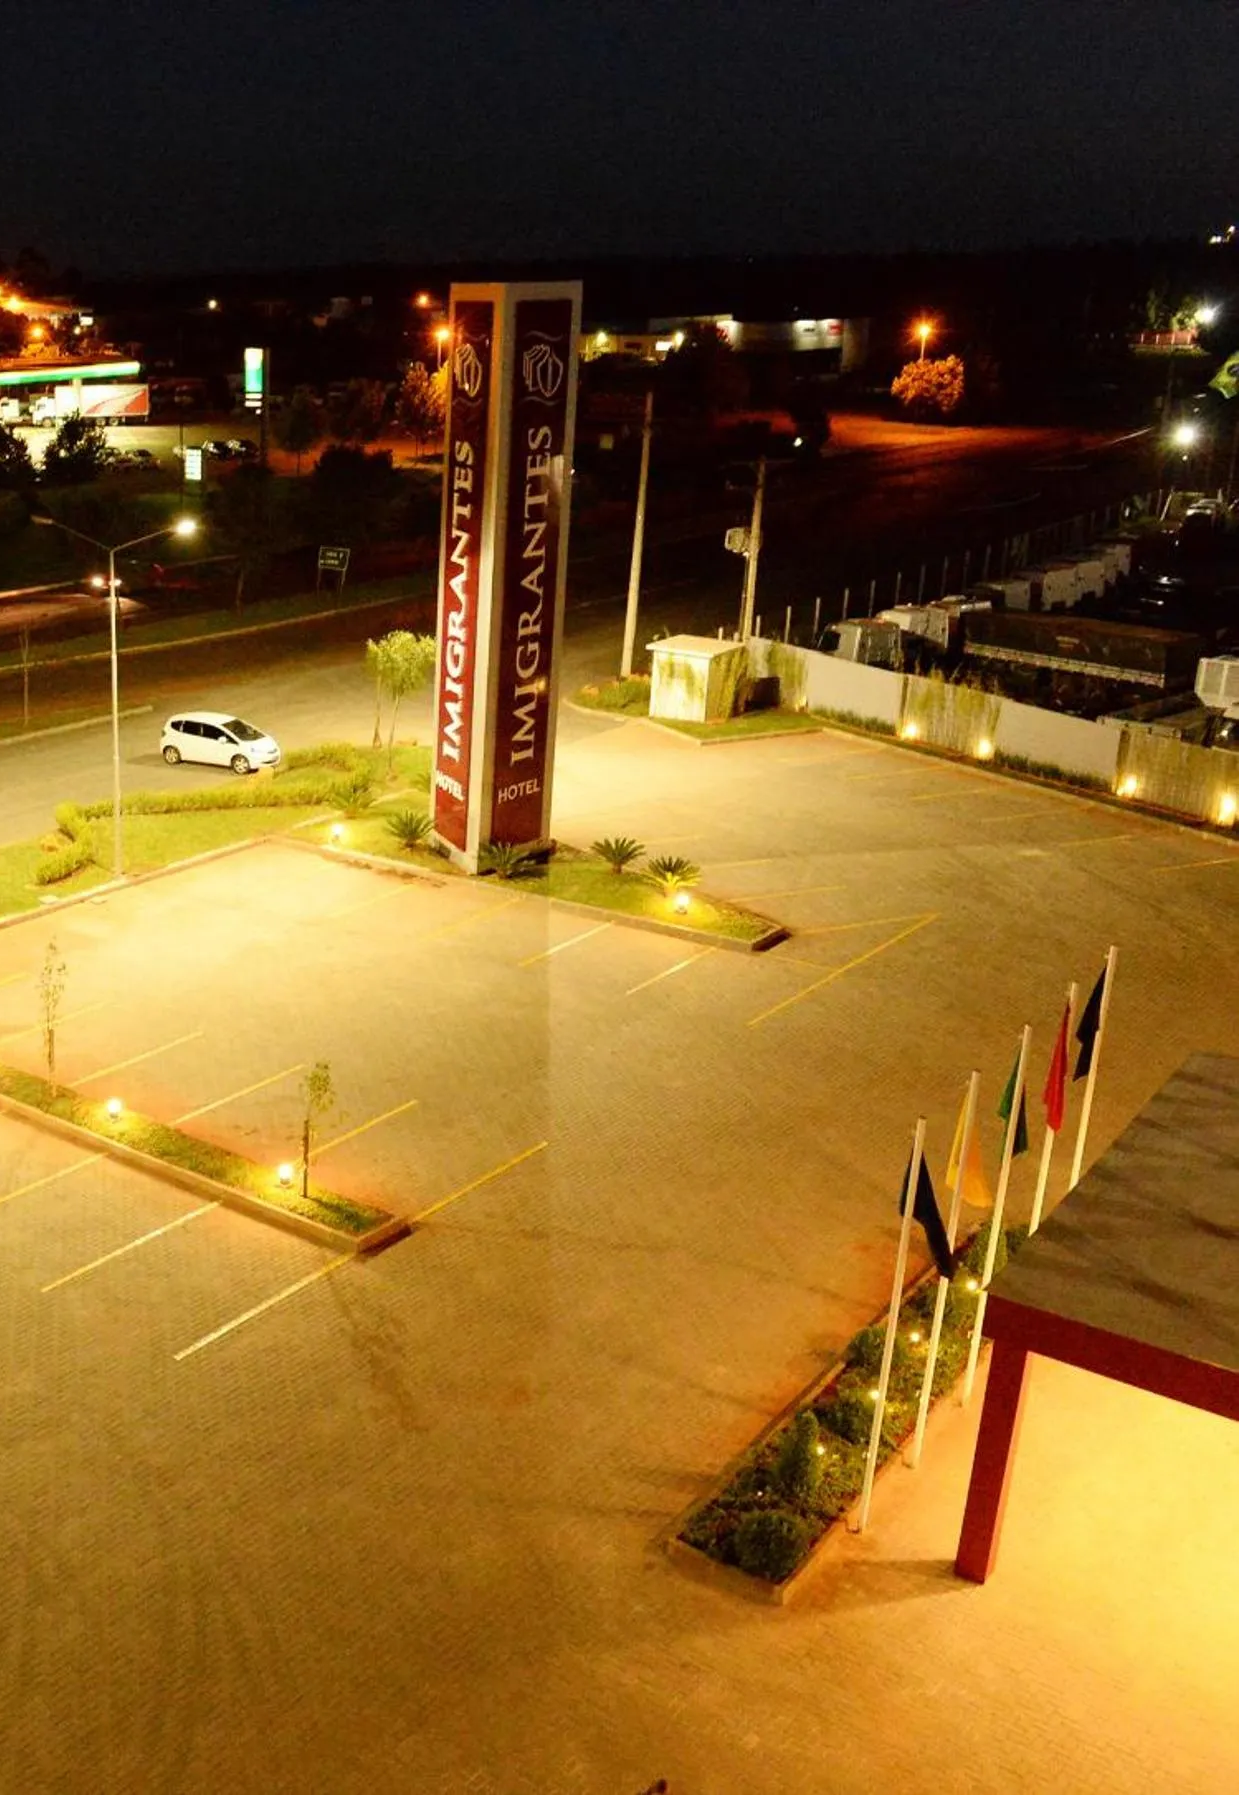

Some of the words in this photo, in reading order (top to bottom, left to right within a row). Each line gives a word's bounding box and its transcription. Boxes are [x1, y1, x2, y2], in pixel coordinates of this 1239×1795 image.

[442, 440, 474, 763] IMIGRANTES
[510, 425, 553, 767] IMIGRANTES
[498, 777, 541, 804] HOTEL
